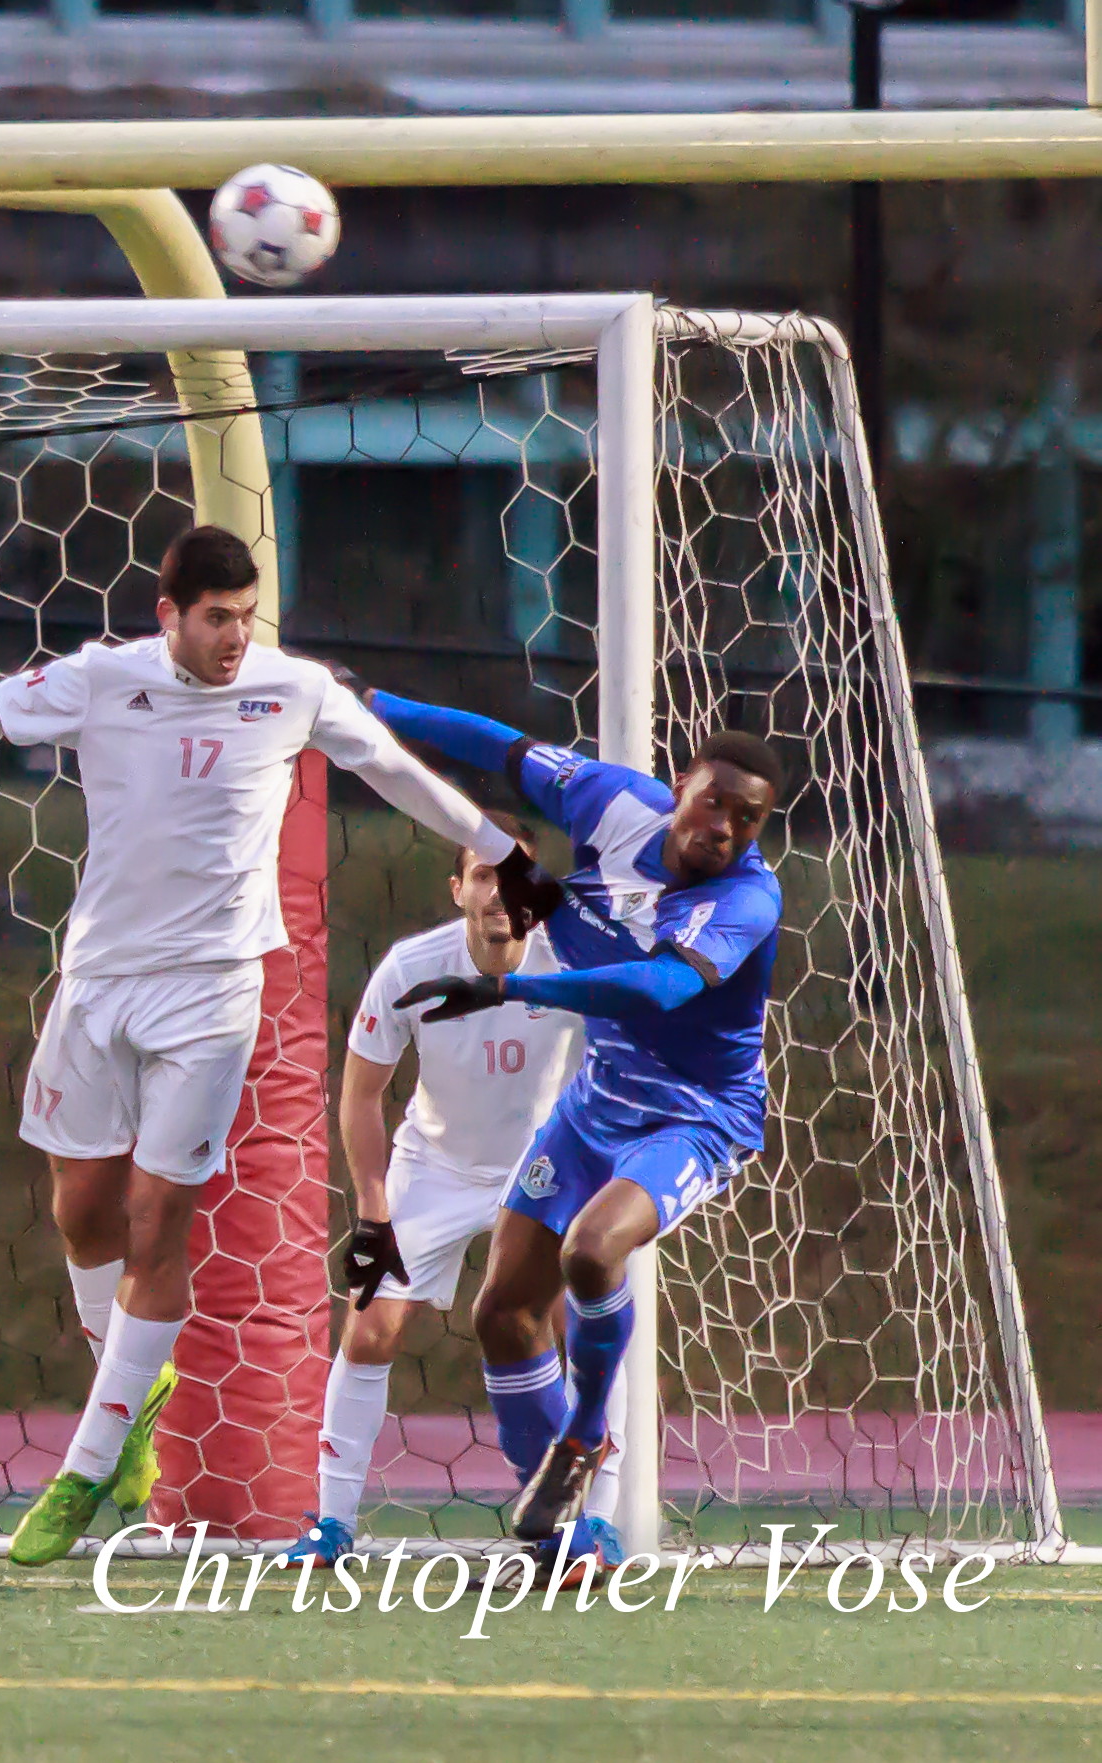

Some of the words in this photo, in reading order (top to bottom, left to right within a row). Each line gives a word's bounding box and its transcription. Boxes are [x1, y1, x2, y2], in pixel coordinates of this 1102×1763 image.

[237, 700, 271, 714] SFU
[179, 737, 224, 779] 17
[483, 1038, 526, 1075] 10
[32, 1076, 63, 1122] 17
